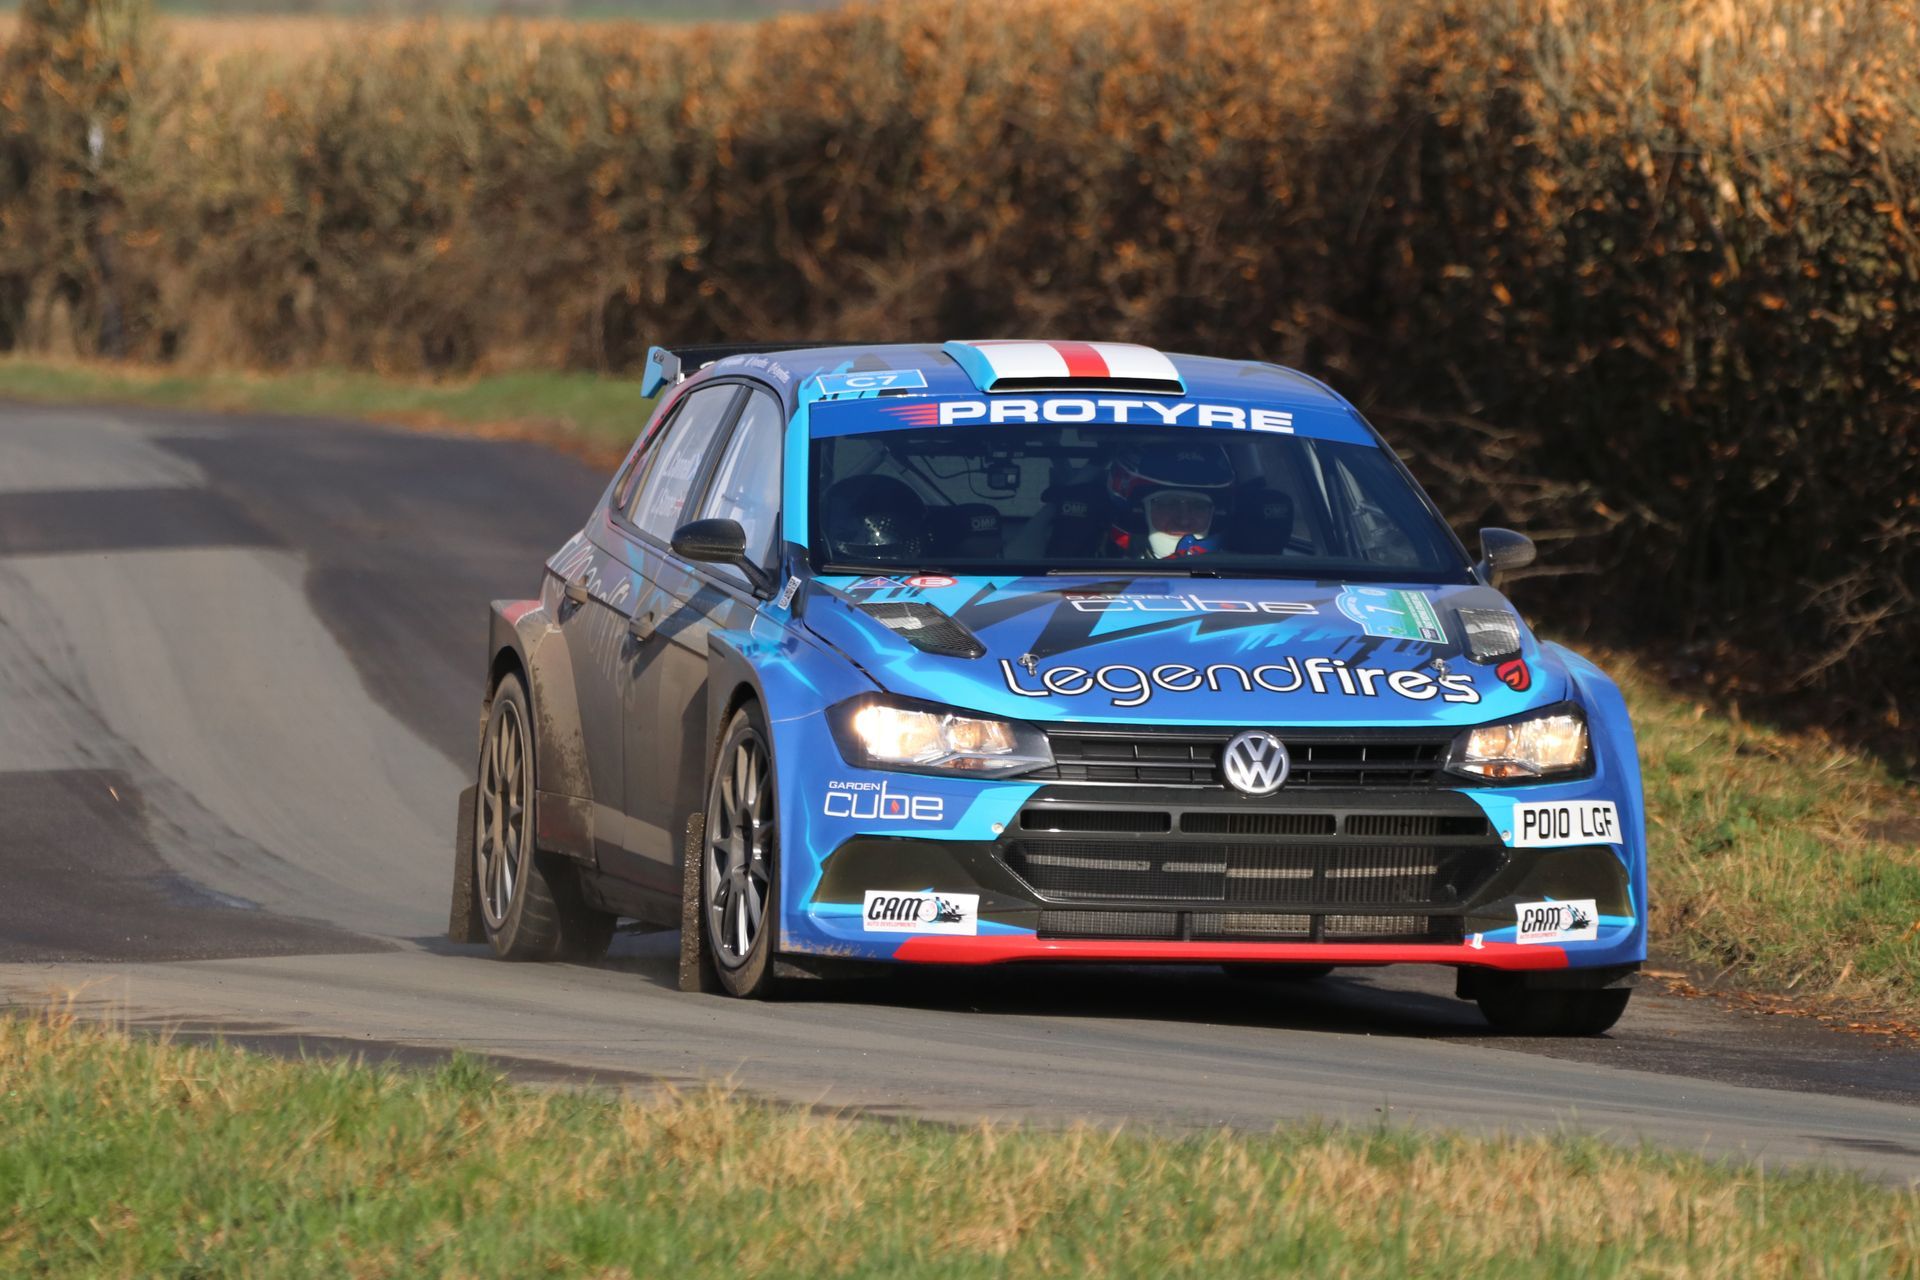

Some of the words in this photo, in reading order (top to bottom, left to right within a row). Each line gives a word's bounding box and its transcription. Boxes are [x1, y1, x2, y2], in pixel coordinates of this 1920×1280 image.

[846, 375, 898, 388] C7
[938, 398, 1295, 435] PROTYRE
[1071, 594, 1320, 615] cube
[828, 780, 881, 791] GARDEN
[824, 780, 943, 821] cube
[1580, 807, 1613, 837] LGF
